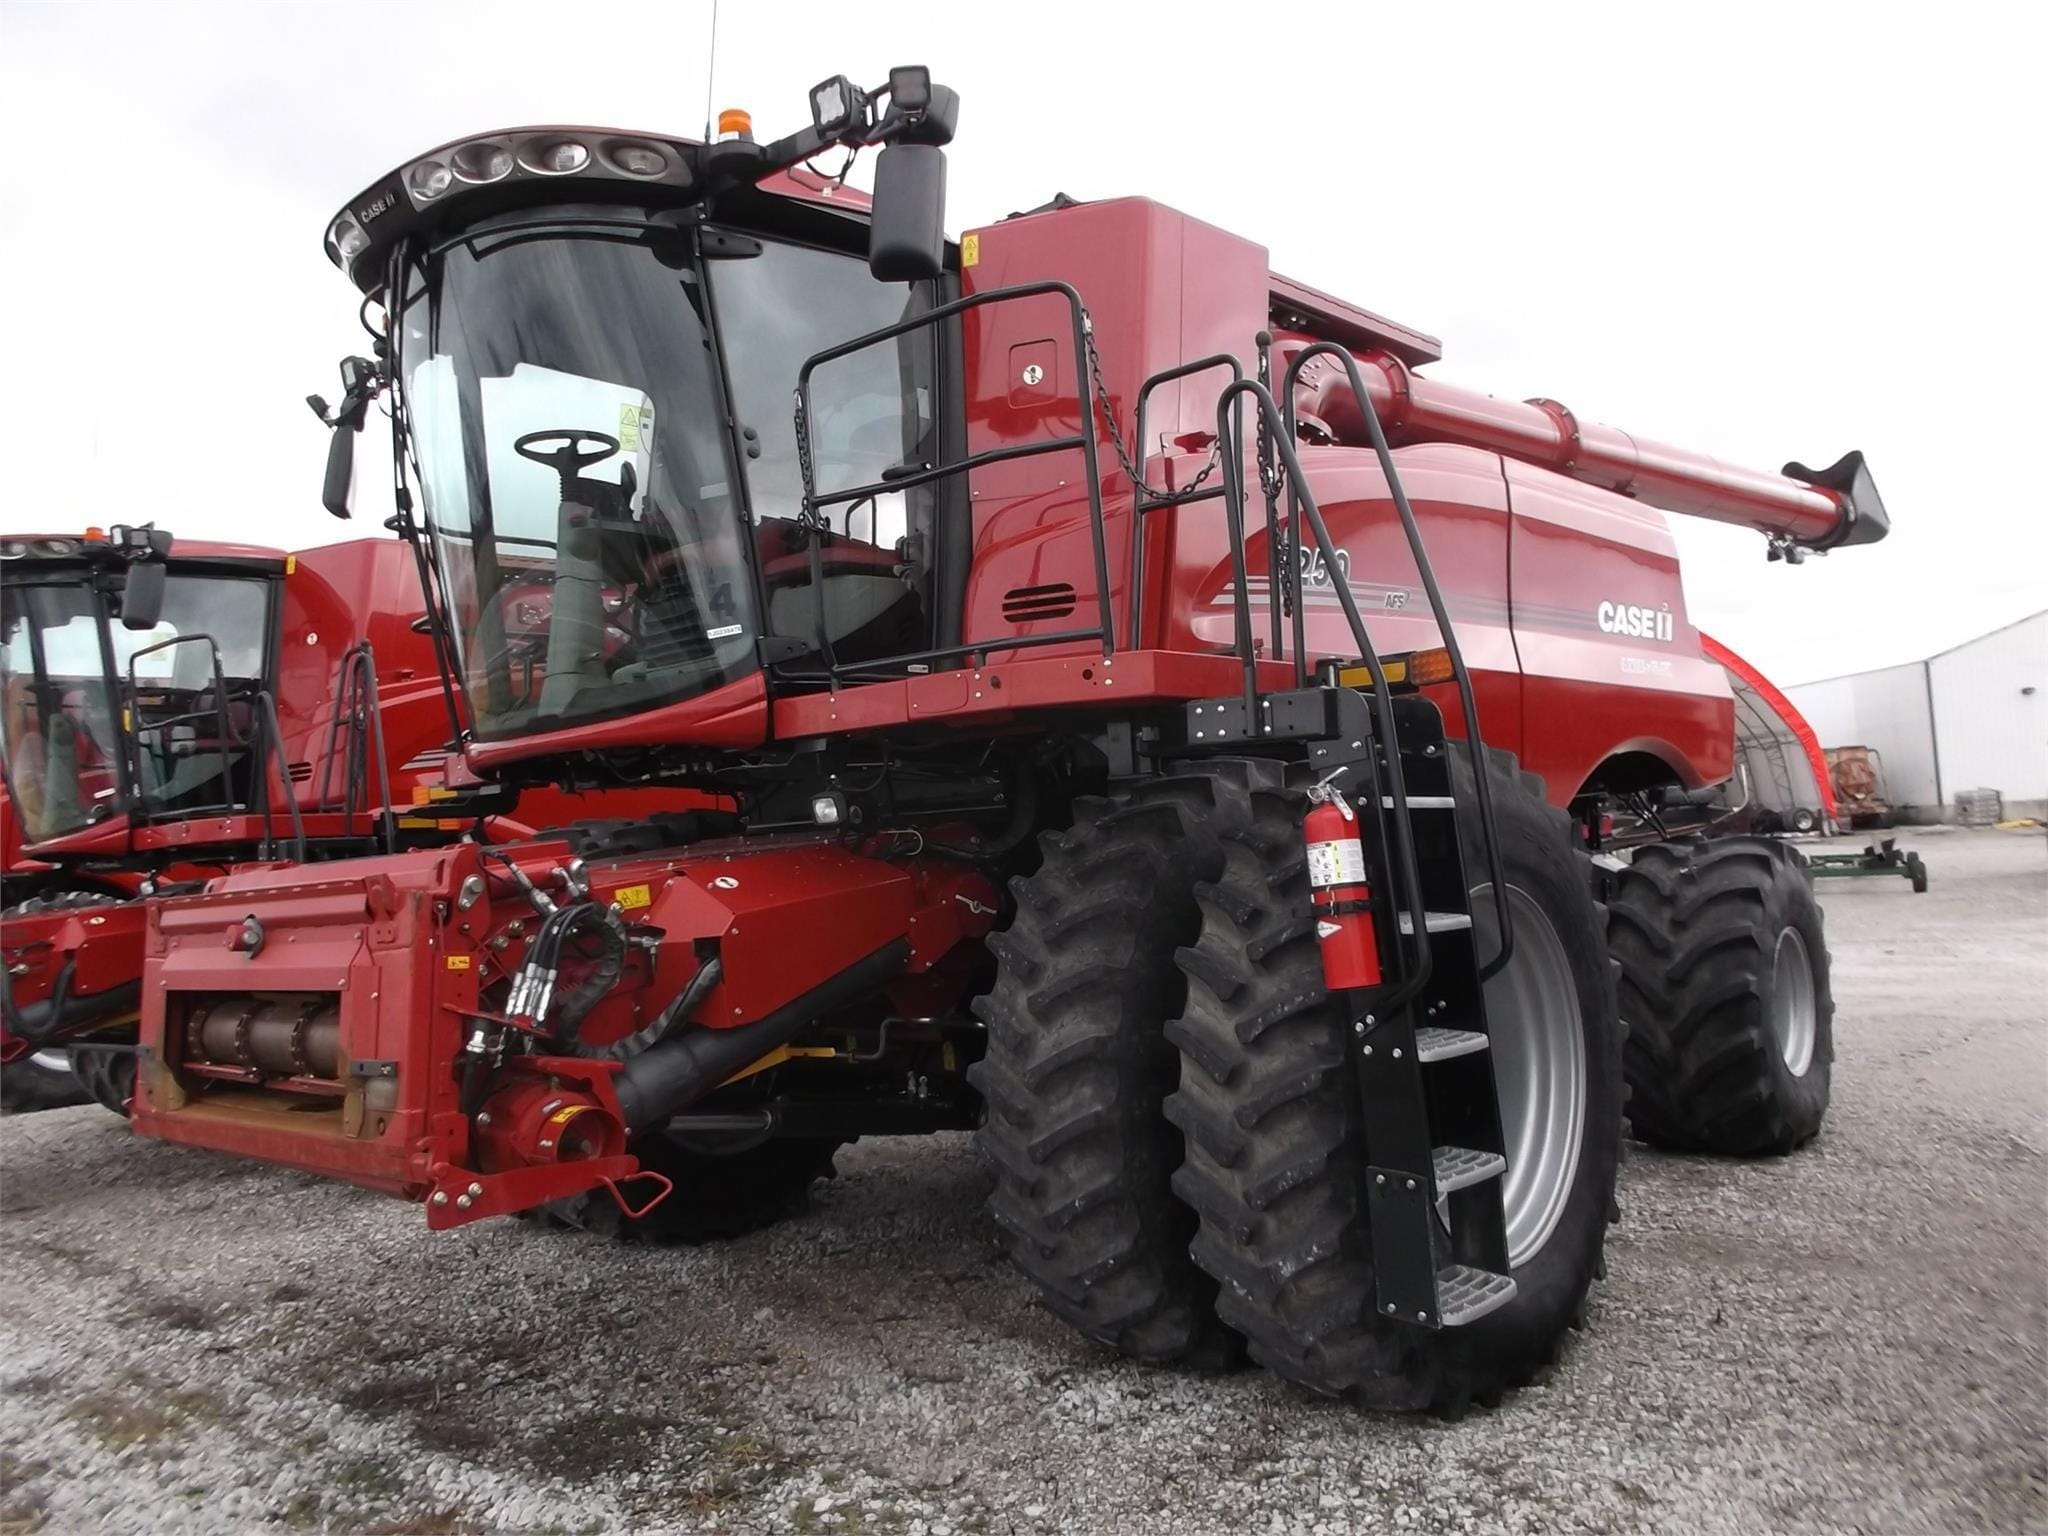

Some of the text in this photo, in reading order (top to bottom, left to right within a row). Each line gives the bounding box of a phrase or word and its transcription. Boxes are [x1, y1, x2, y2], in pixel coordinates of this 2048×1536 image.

[361, 199, 387, 223] CASE
[1385, 591, 1405, 609] AFS
[1598, 600, 1655, 639] CASE
